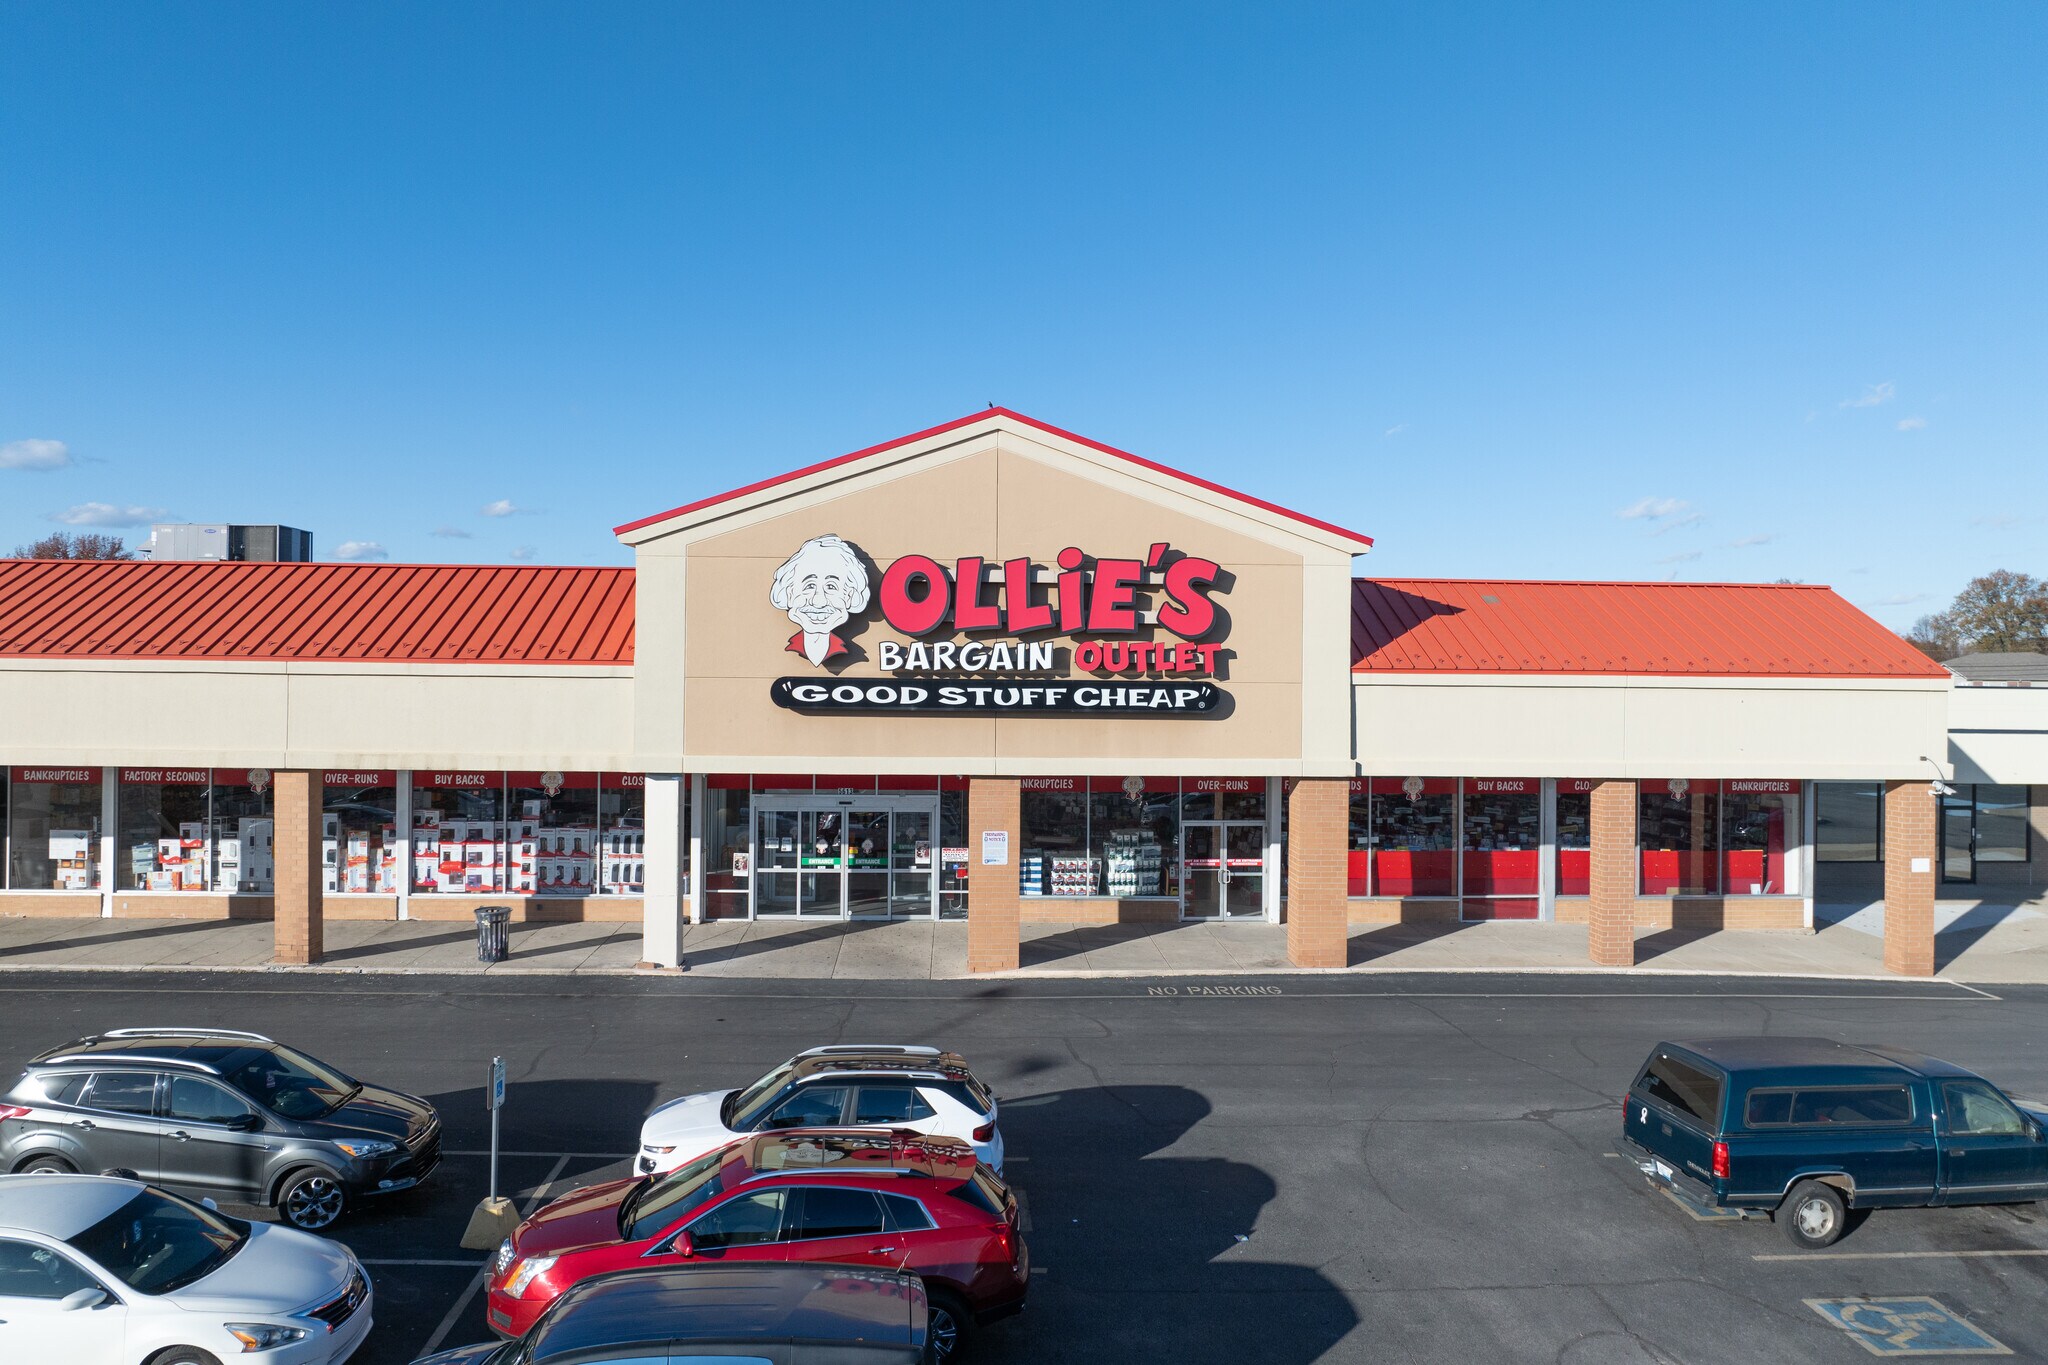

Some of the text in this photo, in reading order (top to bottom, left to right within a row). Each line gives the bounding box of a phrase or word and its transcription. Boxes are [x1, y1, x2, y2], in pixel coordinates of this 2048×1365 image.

[879, 641, 1222, 673] BARGAIN OUTLET
[938, 687, 1068, 706] STUFF
[24, 771, 90, 781] BANKRUPTCIES
[124, 770, 206, 783] FACTORY SECONDS
[325, 773, 379, 785] OVER-RUNS
[434, 774, 485, 786] BUY BACKS
[621, 775, 644, 786] CLOS
[1020, 778, 1074, 789] NKRUPTCIES
[1197, 779, 1249, 791] OVER-RUNS
[1477, 781, 1524, 791] BUY BACKS
[1731, 781, 1790, 792] BANKRUPTCIES
[1148, 986, 1282, 995] NO PARKING
